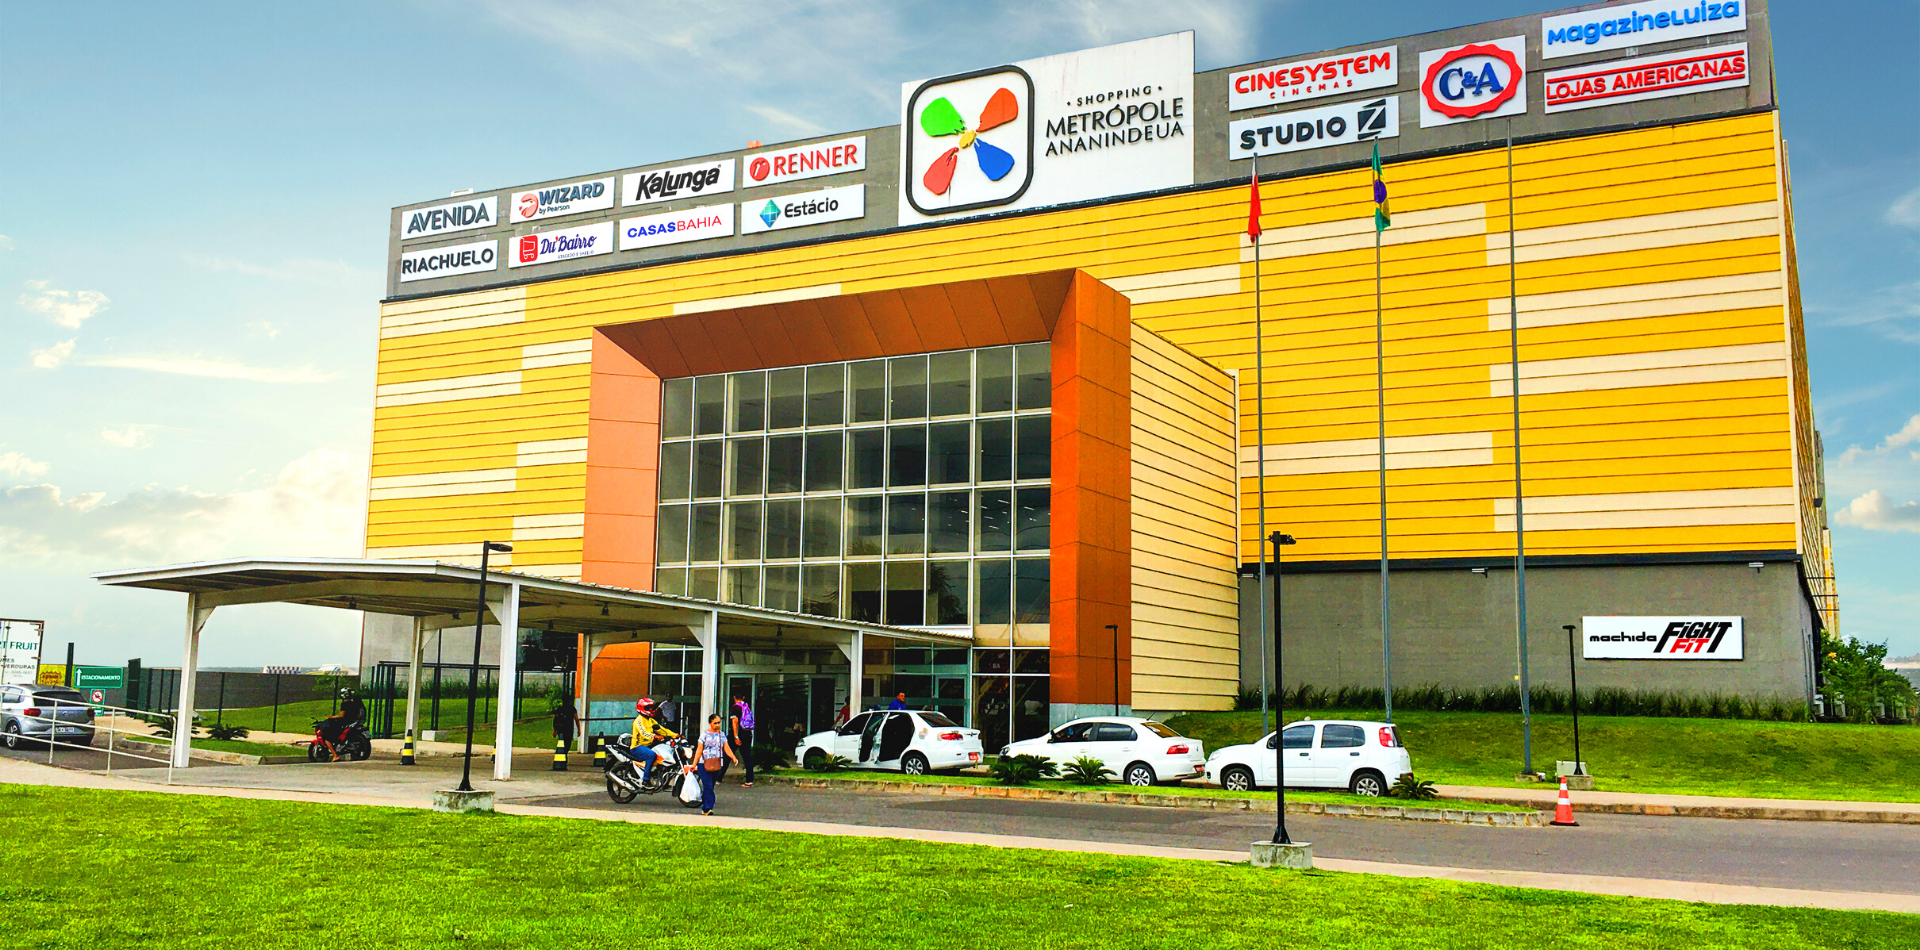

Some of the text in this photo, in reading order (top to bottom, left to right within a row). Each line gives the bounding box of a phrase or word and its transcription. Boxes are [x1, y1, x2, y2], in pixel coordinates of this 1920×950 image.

[1547, 0, 1740, 45] MagazineLuiza
[1235, 52, 1391, 94] CINESYSTEM
[1439, 62, 1504, 100] C&A
[1546, 56, 1746, 100] LOJAS AMERICANAS
[1077, 85, 1152, 106] SHOPPING
[1269, 80, 1353, 99] CINEMAS
[1046, 97, 1184, 138] METRÓPOLE
[1240, 116, 1347, 150] STUDIO
[1045, 121, 1184, 157] ANANINDEUA
[773, 144, 858, 177] RENNER
[538, 182, 605, 206] WIZARD
[539, 204, 570, 215] by Pearson
[784, 197, 839, 218] Estácio
[407, 202, 490, 234] AVENIDA
[401, 248, 494, 275] RIACHUELO
[10, 641, 38, 650] FRUIT
[1589, 631, 1657, 642] machida
